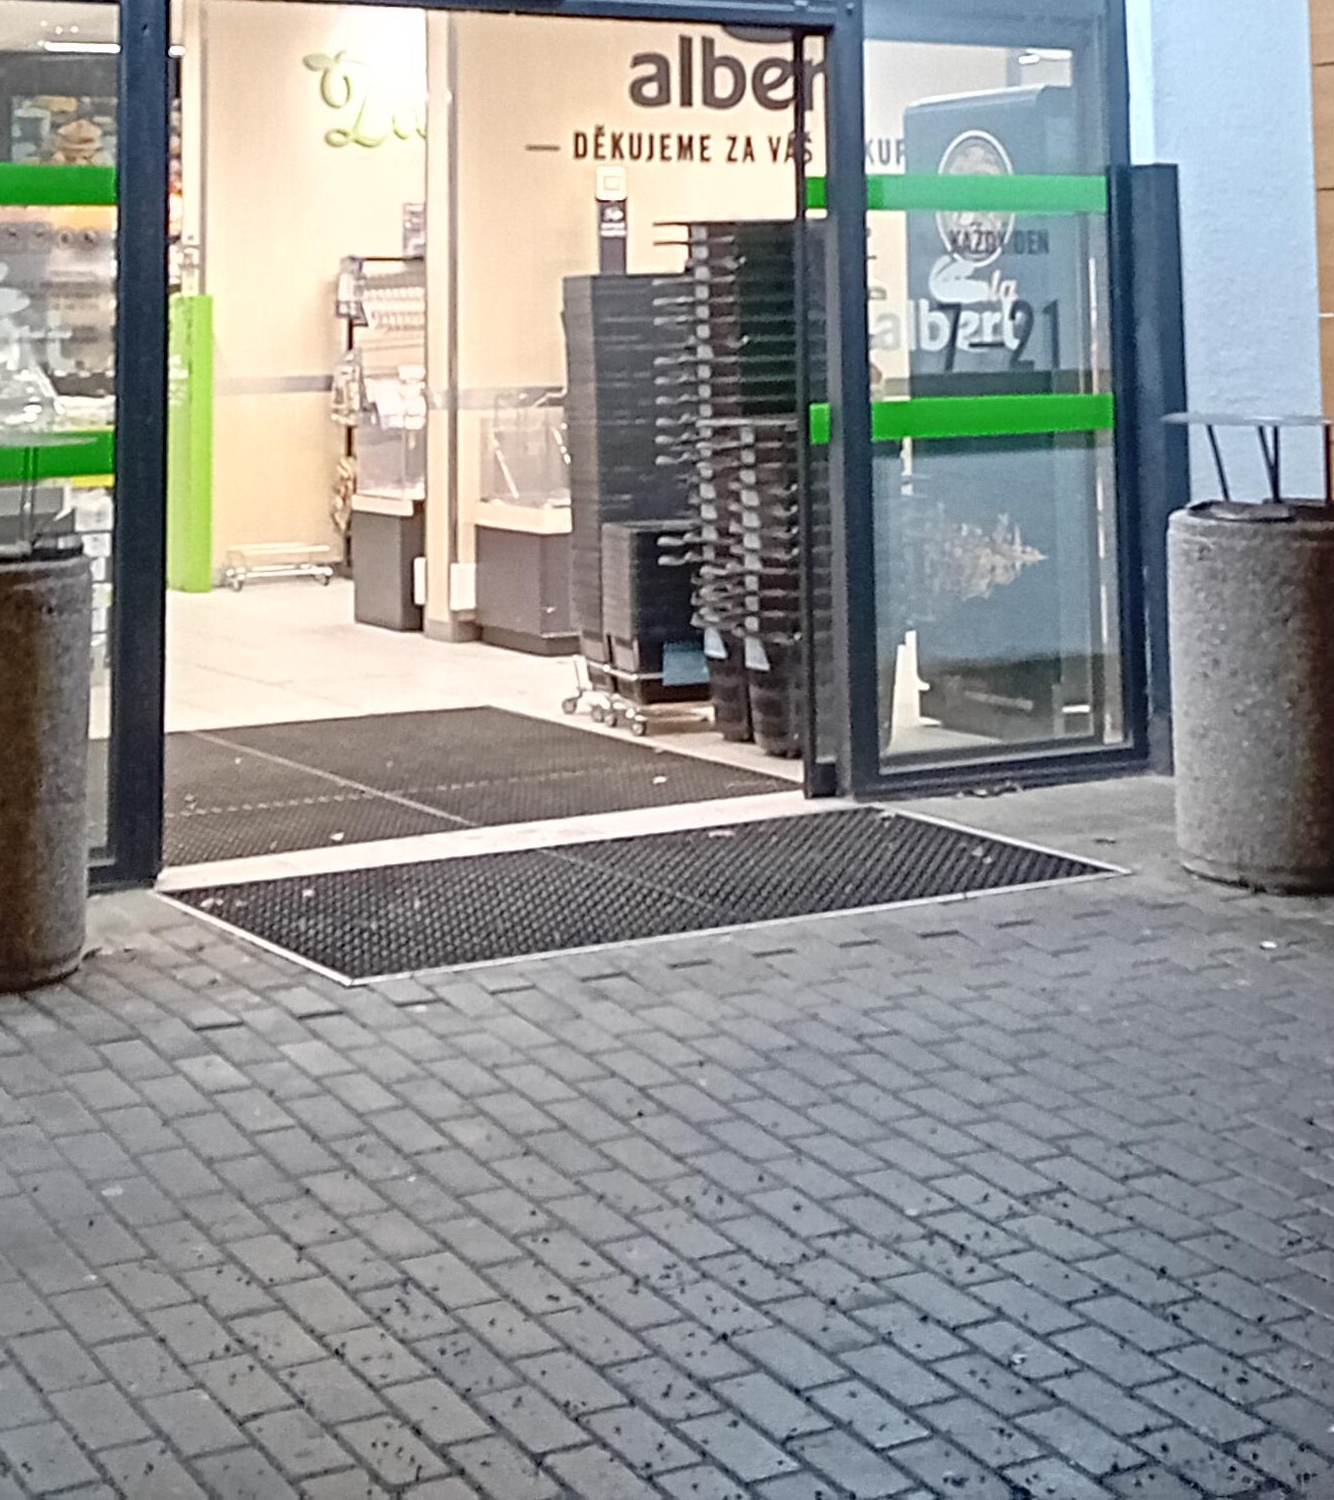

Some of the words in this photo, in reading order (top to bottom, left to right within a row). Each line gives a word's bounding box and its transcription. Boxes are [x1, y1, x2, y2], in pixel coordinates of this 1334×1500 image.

[573, 124, 712, 162] DĚKUJEME
[726, 134, 756, 162] ZA
[1013, 229, 1050, 255] DEN
